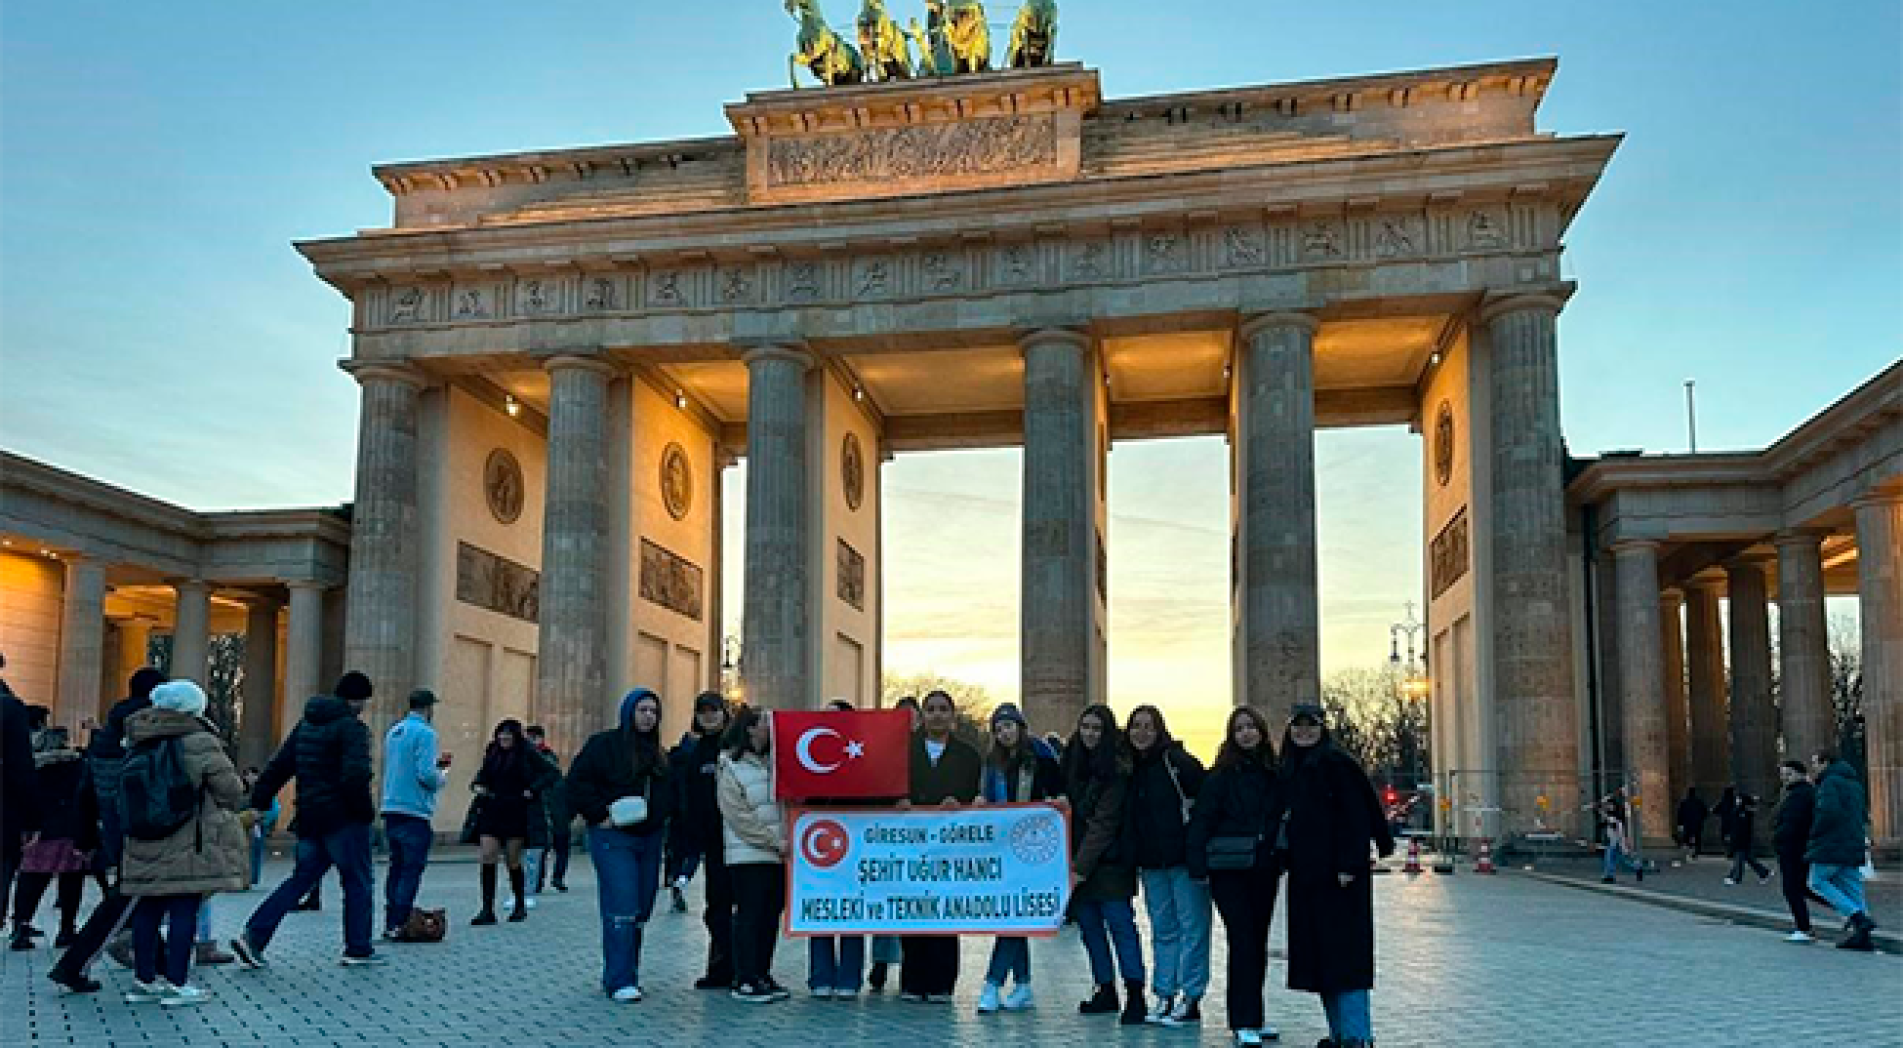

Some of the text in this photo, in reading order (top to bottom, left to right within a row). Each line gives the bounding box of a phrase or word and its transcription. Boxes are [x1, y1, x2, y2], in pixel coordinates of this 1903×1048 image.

[859, 852, 1002, 884] ŞEHİT UĞUR HANCI
[801, 887, 1060, 921] MESLEKİ ve TEKNİK ANADOLU LİSESİ
